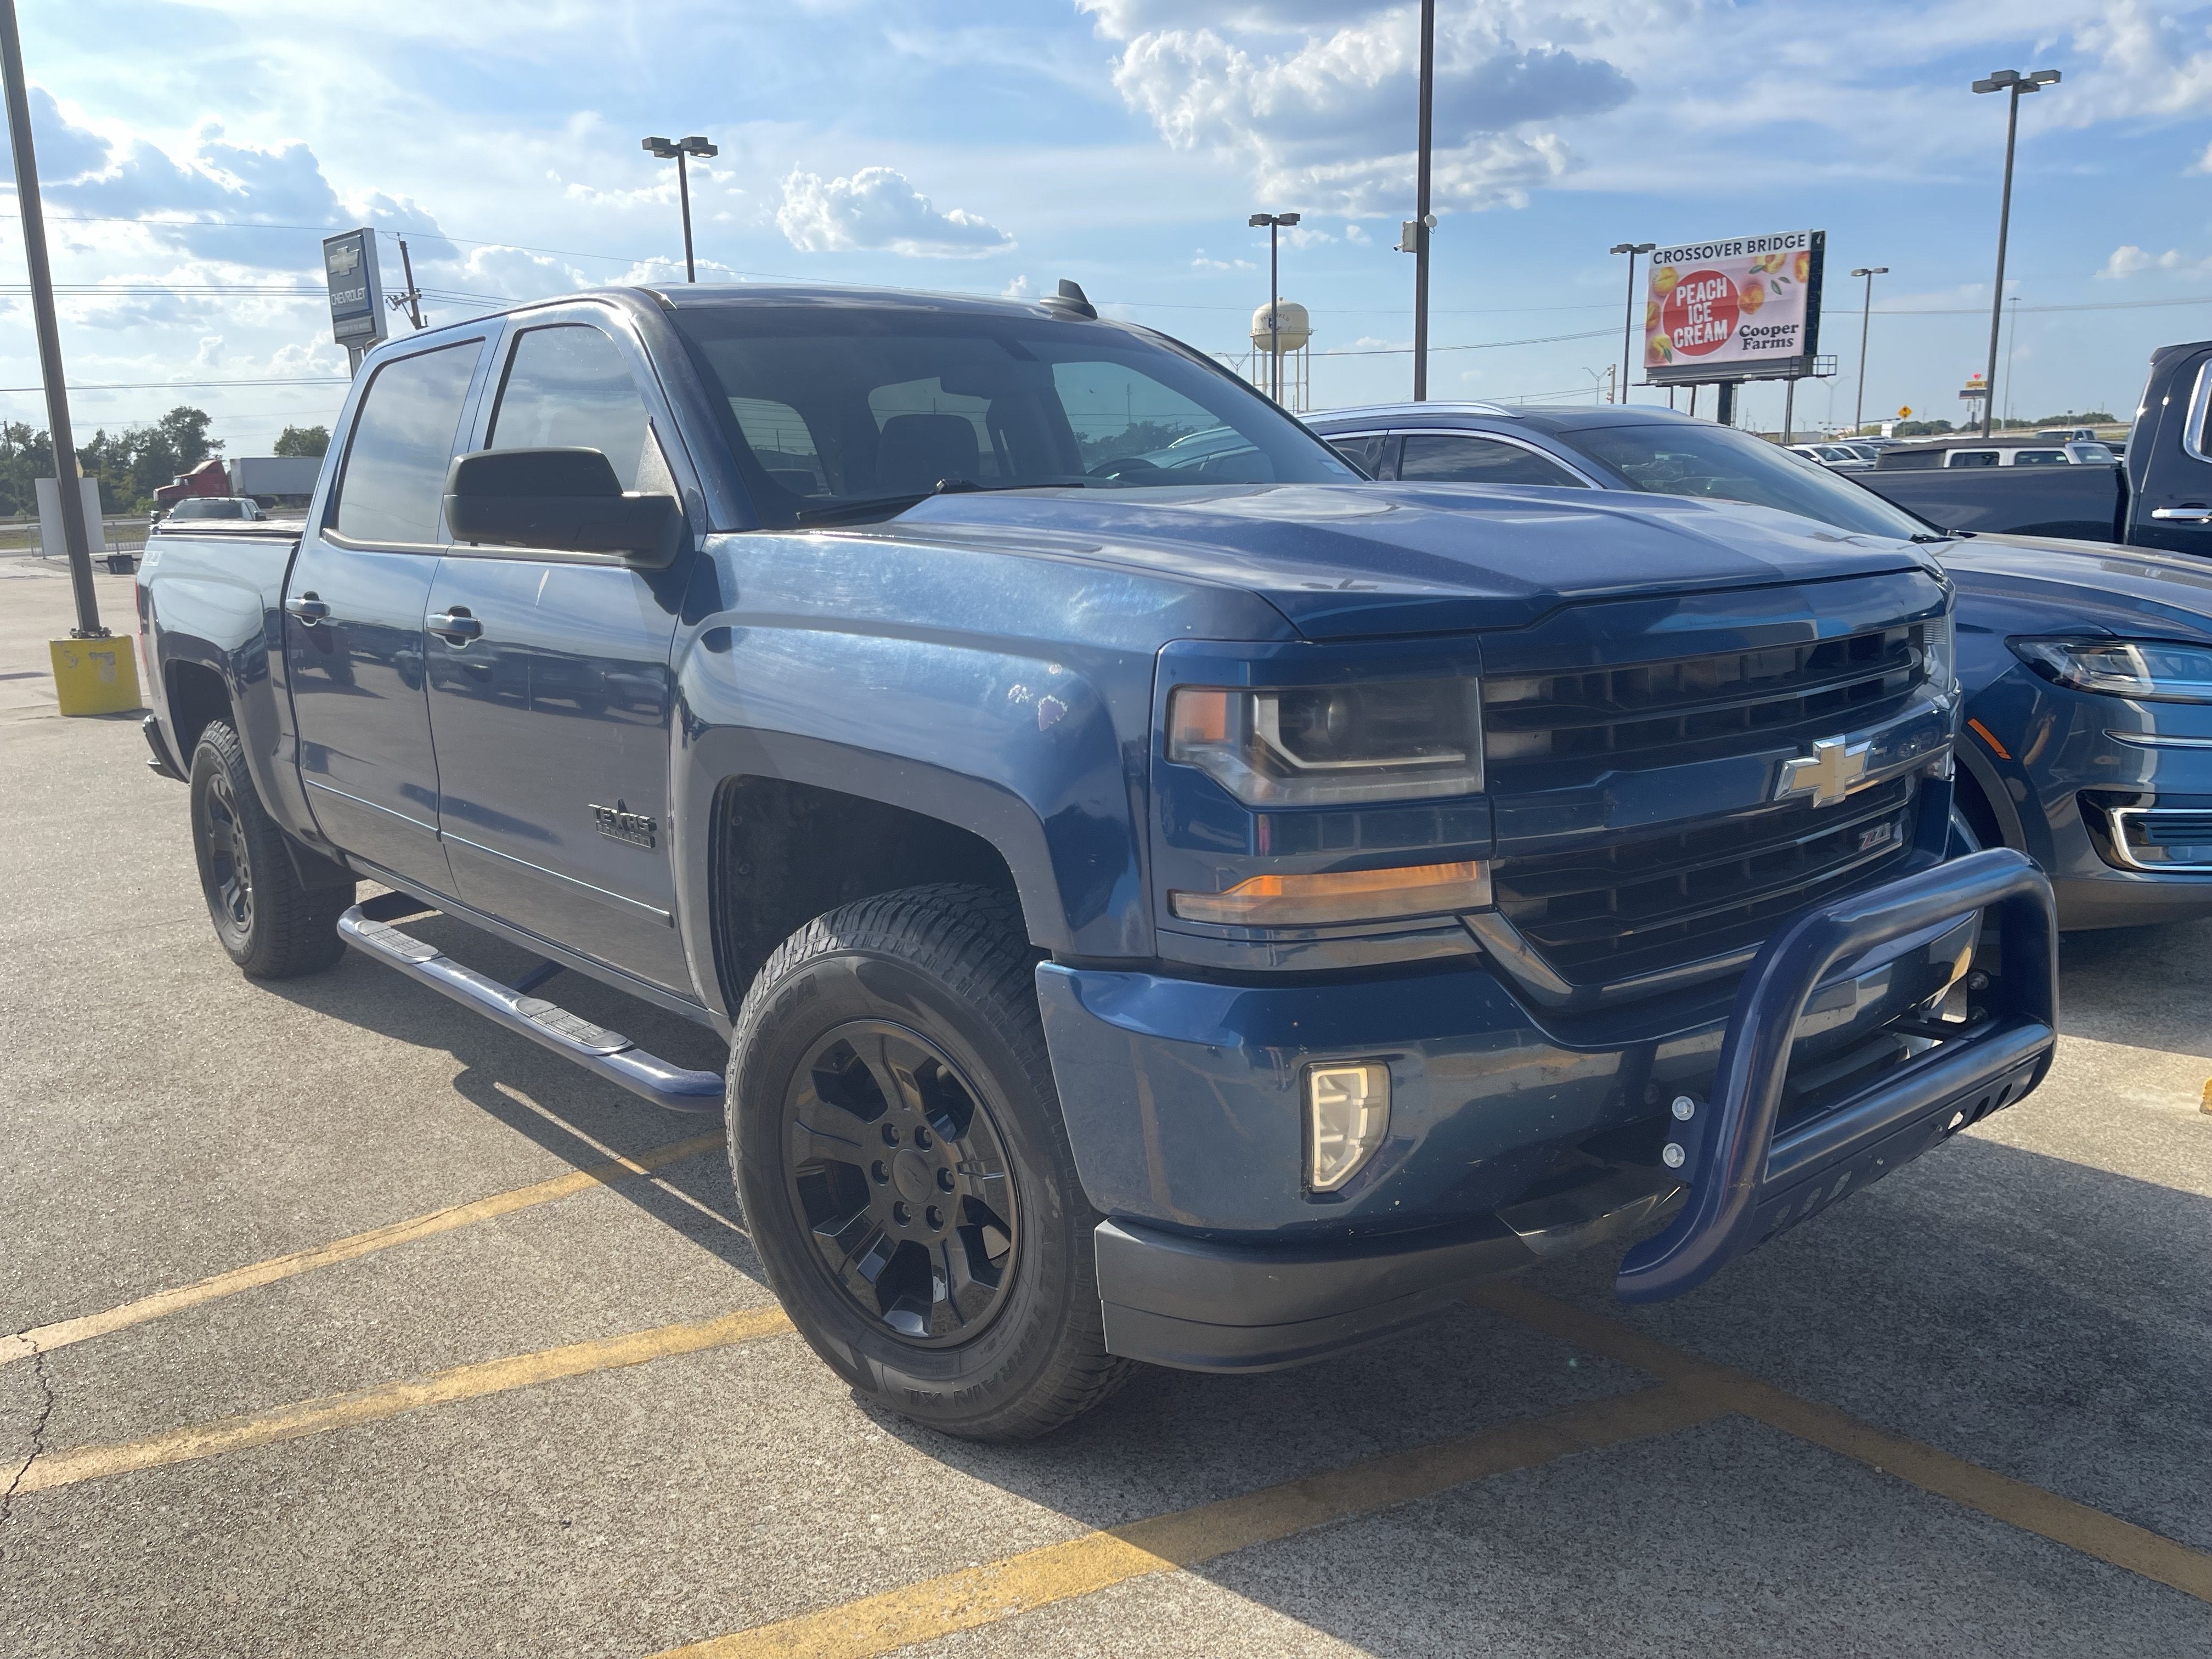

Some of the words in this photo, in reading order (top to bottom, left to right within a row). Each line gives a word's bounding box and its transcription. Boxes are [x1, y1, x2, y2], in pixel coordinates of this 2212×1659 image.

[1653, 242, 1742, 264] CROSSOVER
[1747, 234, 1806, 253] BRIDGE
[331, 287, 365, 305] CHEVROLET
[1676, 277, 1728, 306] PEACH
[1688, 302, 1713, 325] ICE
[1673, 319, 1728, 348] CREAM
[1739, 323, 1799, 337] Cooper
[1742, 336, 1794, 351] Farms
[588, 799, 657, 833] TEXAS
[738, 973, 819, 1109] CORSA
